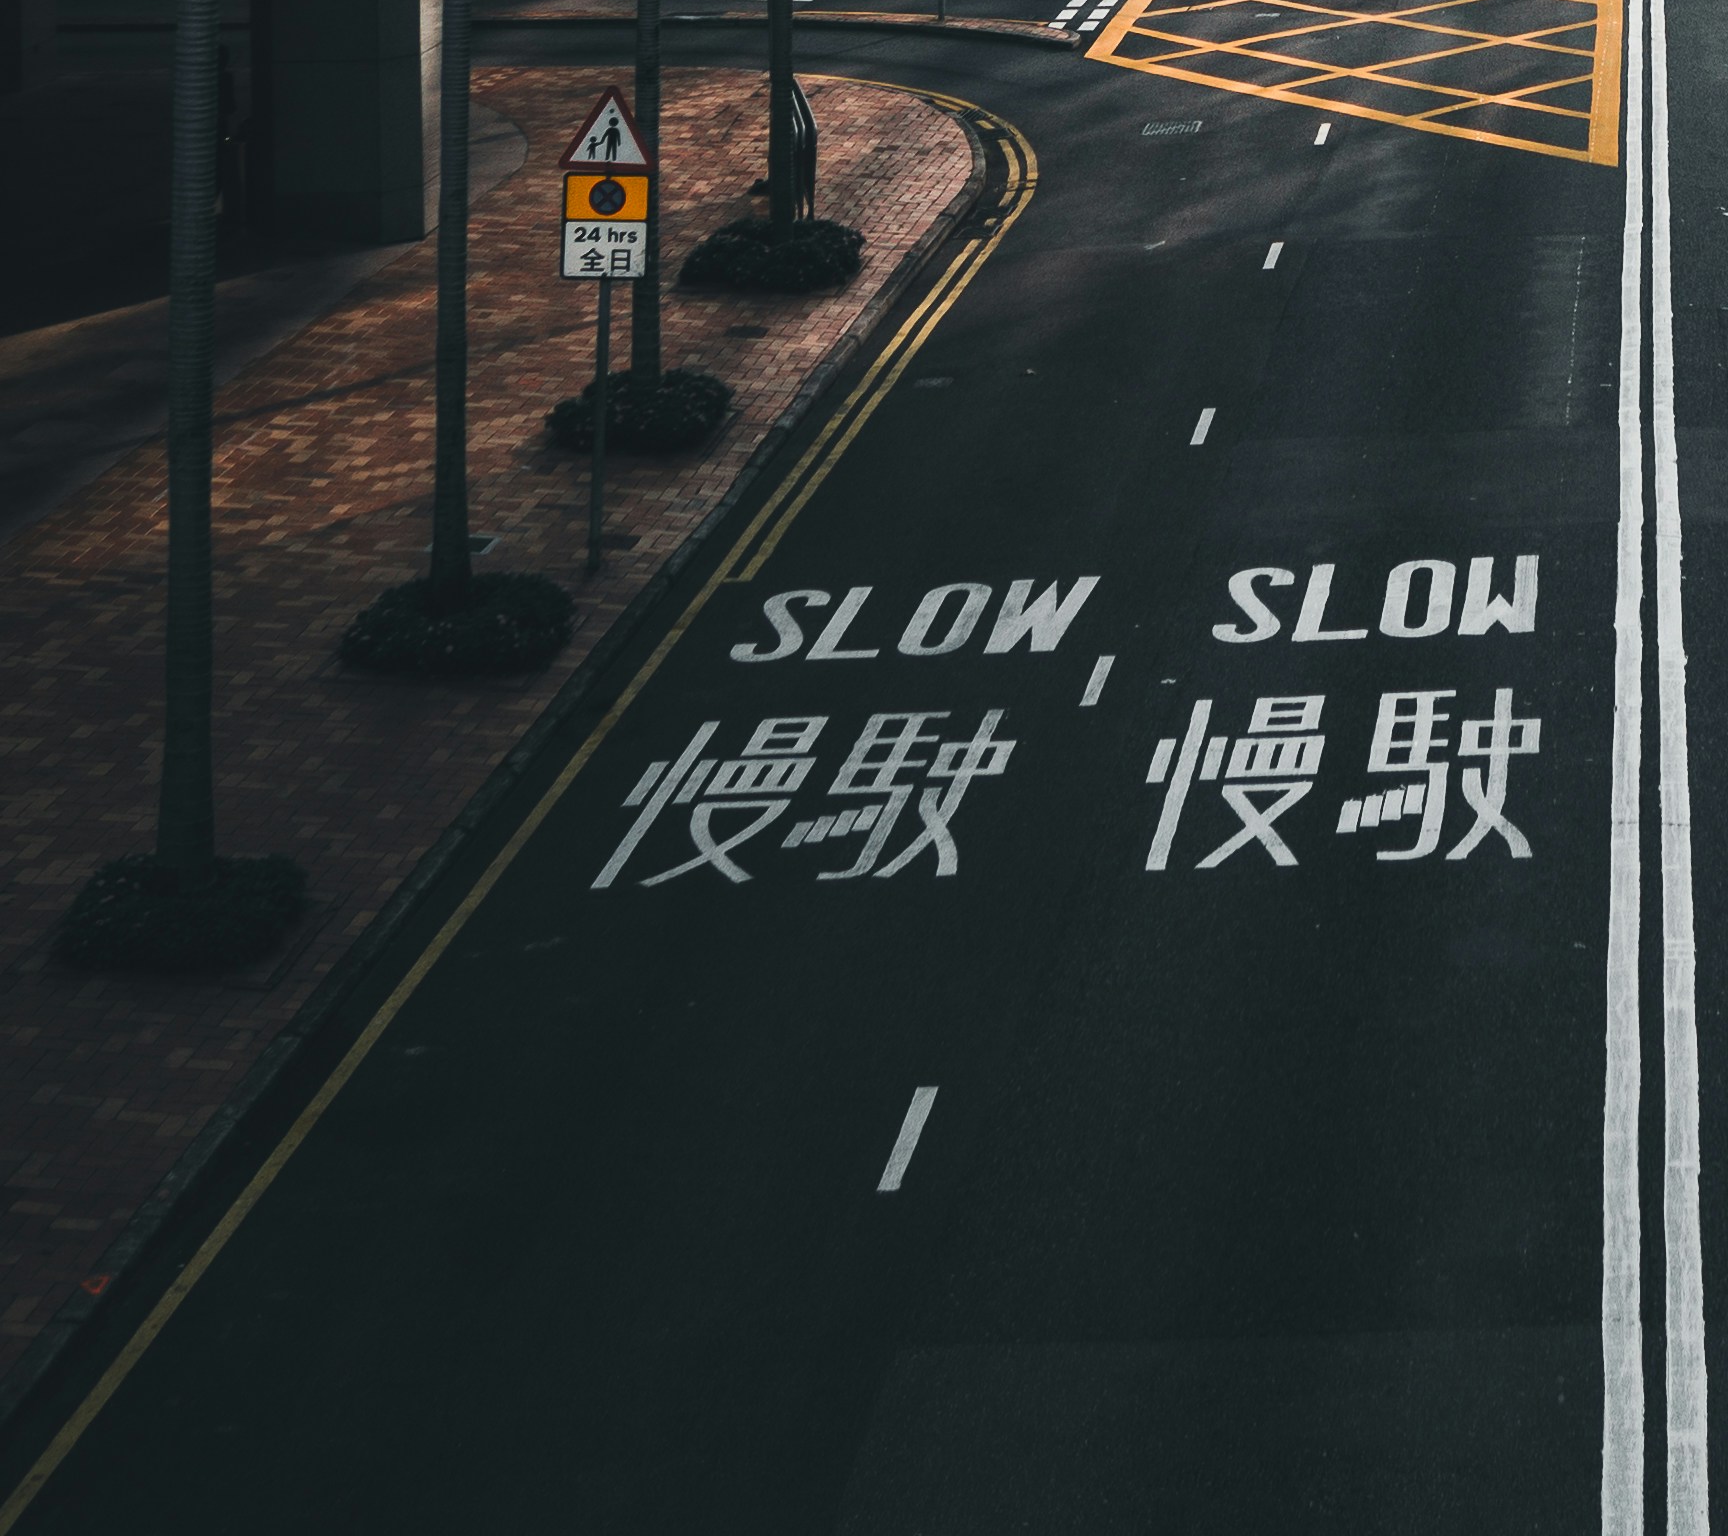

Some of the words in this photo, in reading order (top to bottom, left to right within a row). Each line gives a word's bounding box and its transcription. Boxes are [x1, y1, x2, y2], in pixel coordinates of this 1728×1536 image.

[574, 226, 602, 243] 24
[607, 227, 638, 244] hrs
[579, 247, 633, 273] 全日
[729, 575, 1102, 663] SLOW
[1211, 554, 1540, 644] SLOW
[590, 708, 1018, 889] 慢駛
[1144, 687, 1542, 872] 慢駛
